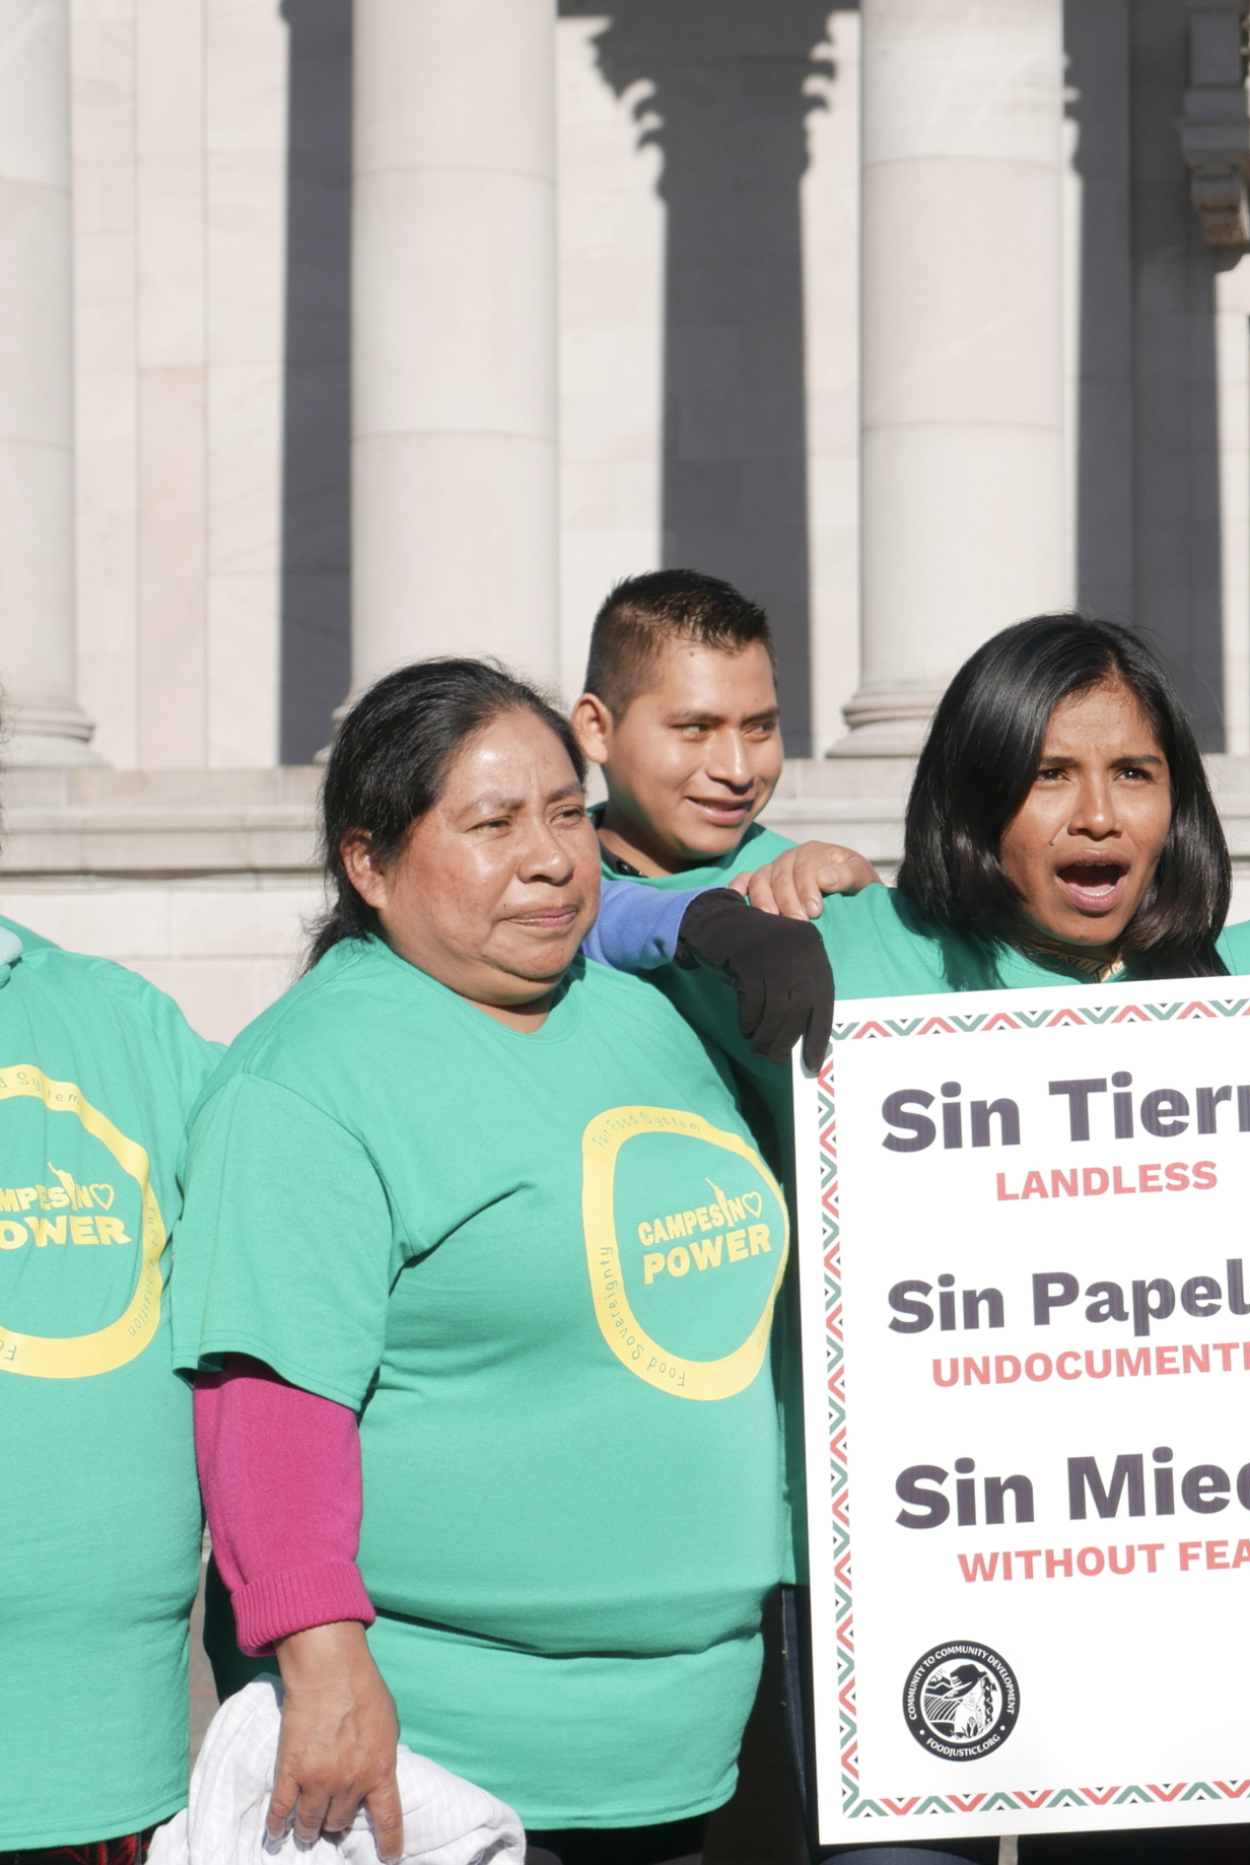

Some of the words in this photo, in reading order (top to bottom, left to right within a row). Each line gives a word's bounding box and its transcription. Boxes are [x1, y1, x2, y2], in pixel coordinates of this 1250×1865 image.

[881, 1081, 1021, 1153] Sin
[996, 1160, 1218, 1202] LANDLESS
[0, 1215, 133, 1250] OWER
[643, 1223, 772, 1285] POWER
[599, 1246, 645, 1361] Sovereignty
[888, 1273, 1005, 1334] Sin
[647, 1355, 686, 1387] Food
[895, 1457, 1035, 1530] Sin
[958, 1543, 1165, 1583] WITHOUT
[907, 1665, 926, 1720] COMMUNITY
[923, 1655, 936, 1667] TO
[934, 1645, 988, 1660] COMMUNITY
[987, 1654, 1016, 1715] DEVELOPMENT
[926, 1733, 1001, 1757] FOODJUSTICE.ORG
